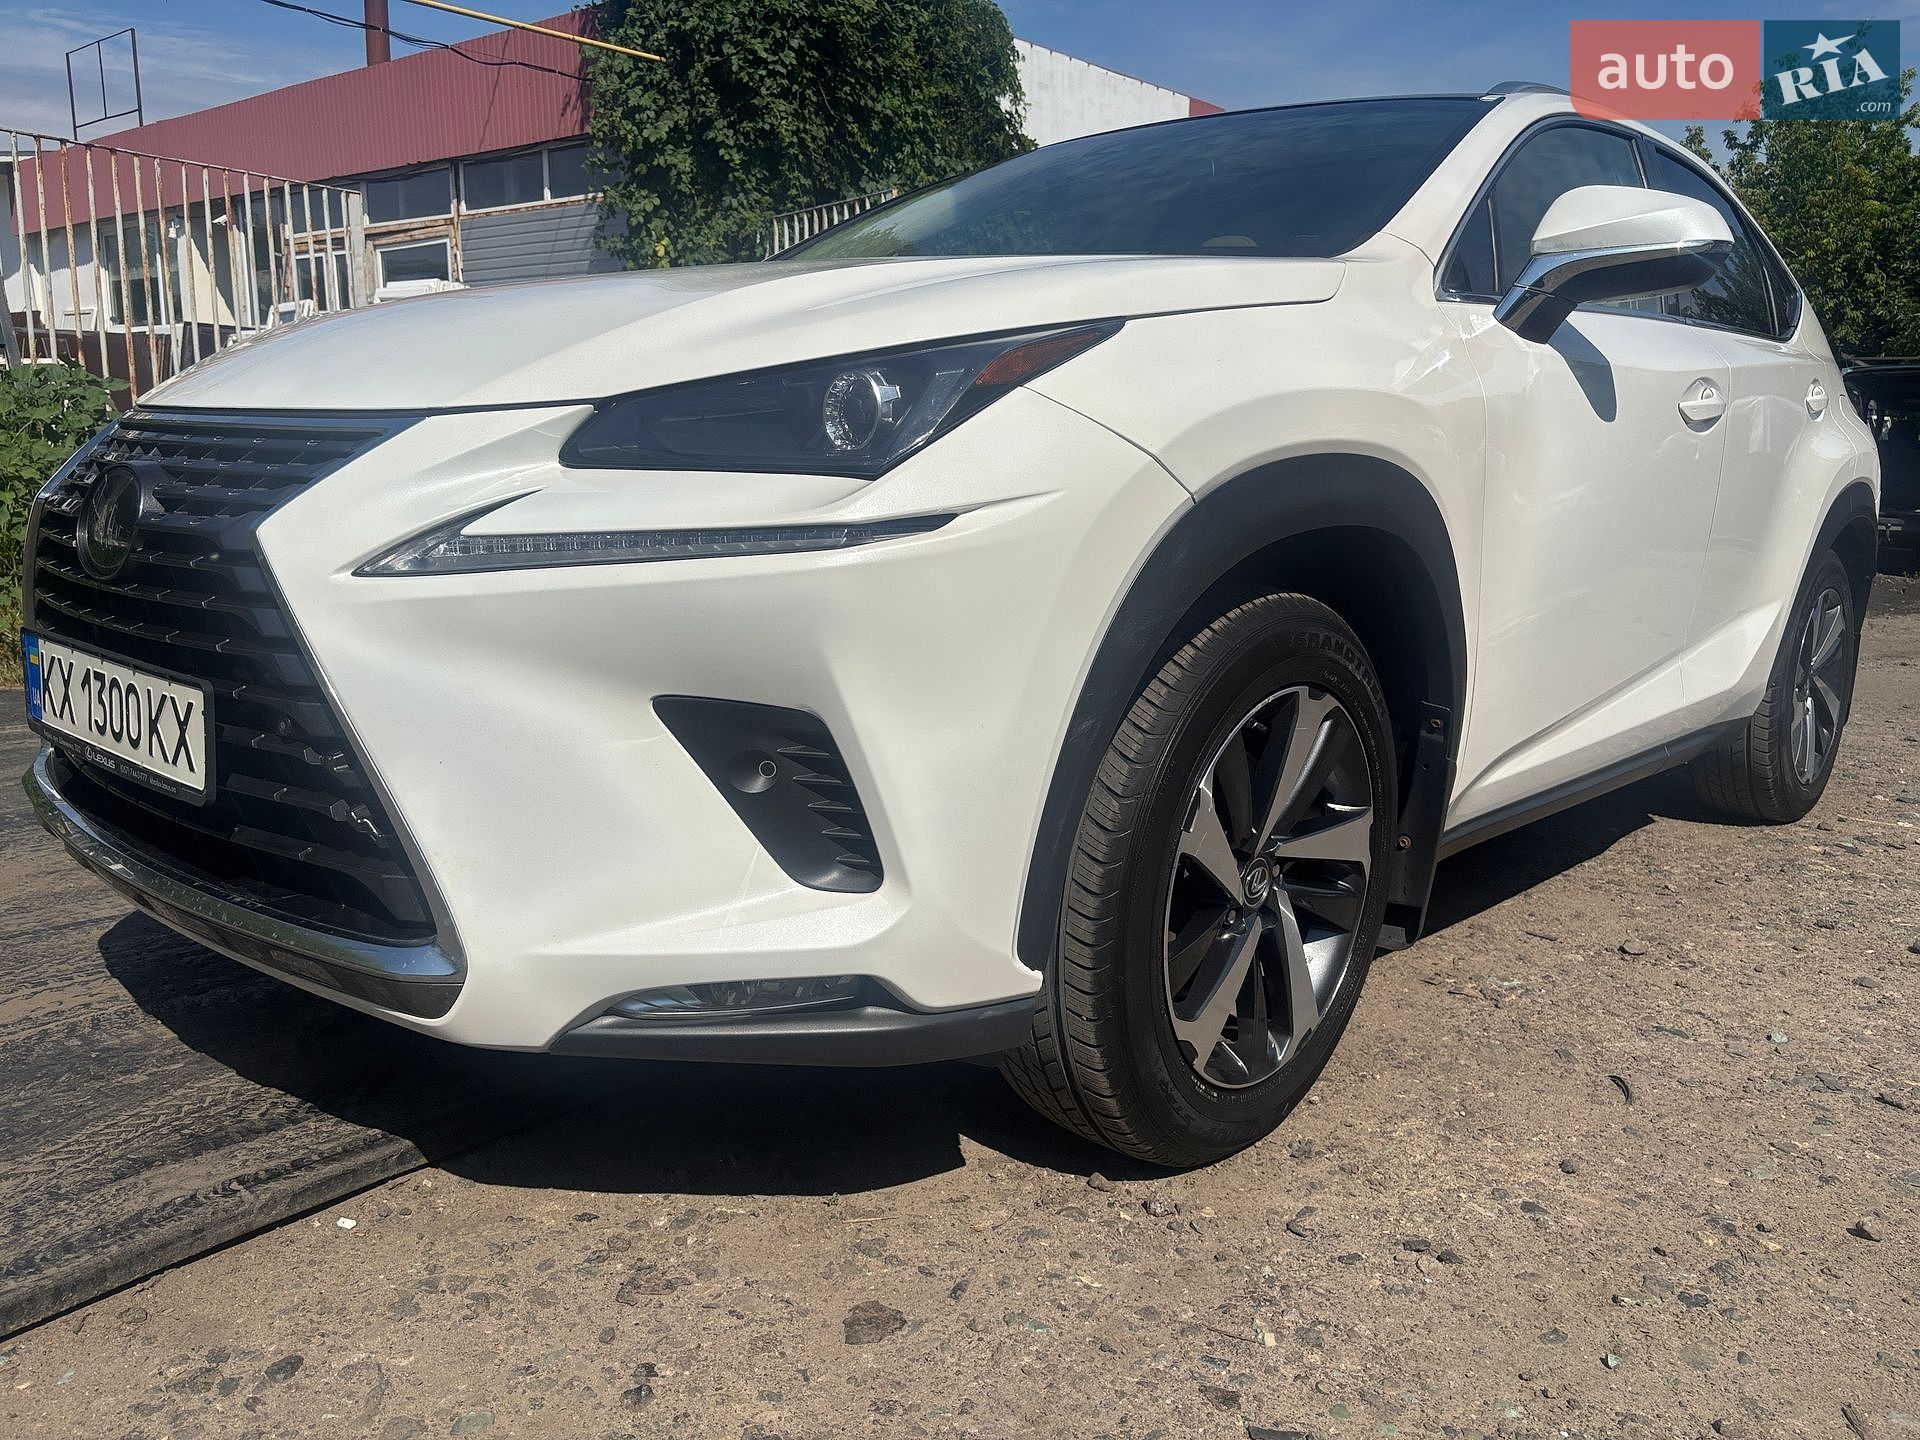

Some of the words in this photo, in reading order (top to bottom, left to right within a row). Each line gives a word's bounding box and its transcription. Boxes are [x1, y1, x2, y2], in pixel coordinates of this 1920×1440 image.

[80, 667, 143, 750] 1300
[146, 688, 197, 774] KX
[92, 751, 117, 769] LEXUS
